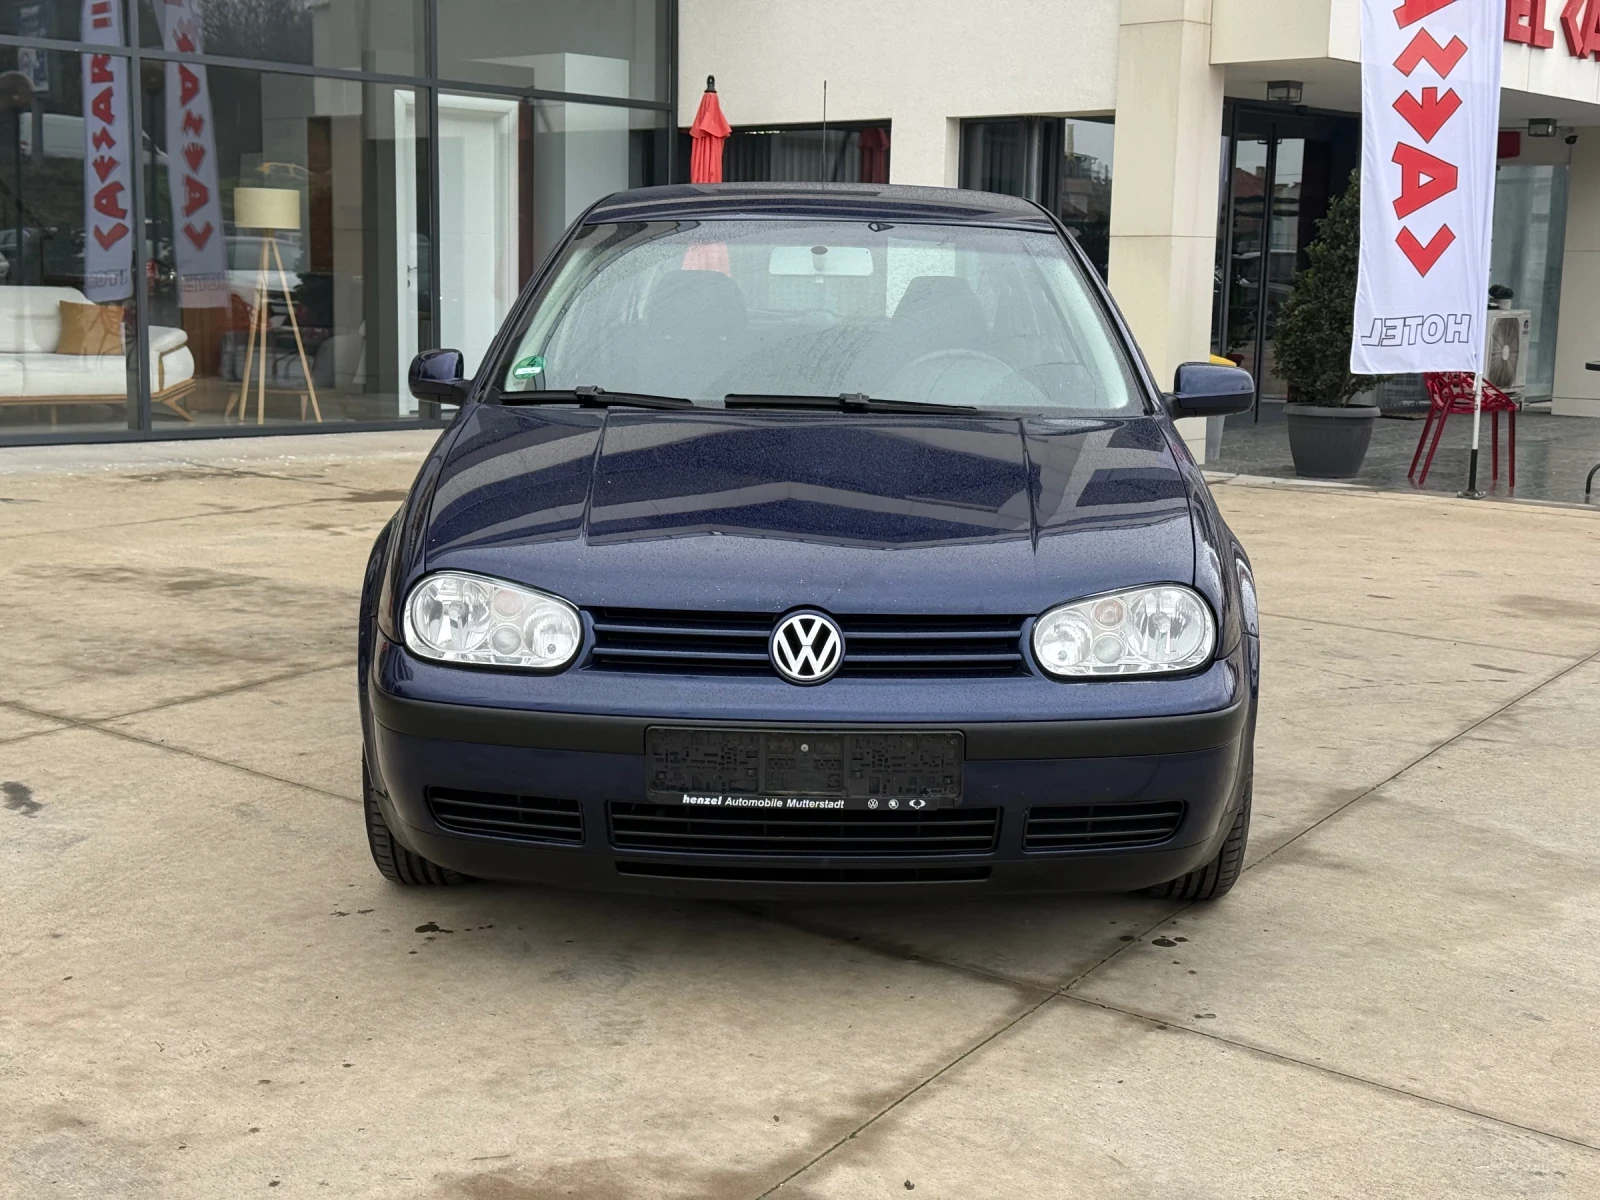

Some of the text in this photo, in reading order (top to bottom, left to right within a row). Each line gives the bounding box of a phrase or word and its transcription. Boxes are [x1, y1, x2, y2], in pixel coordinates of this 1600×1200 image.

[773, 614, 841, 679] VW
[682, 794, 845, 809] henzel Automobile Mutterstadt
